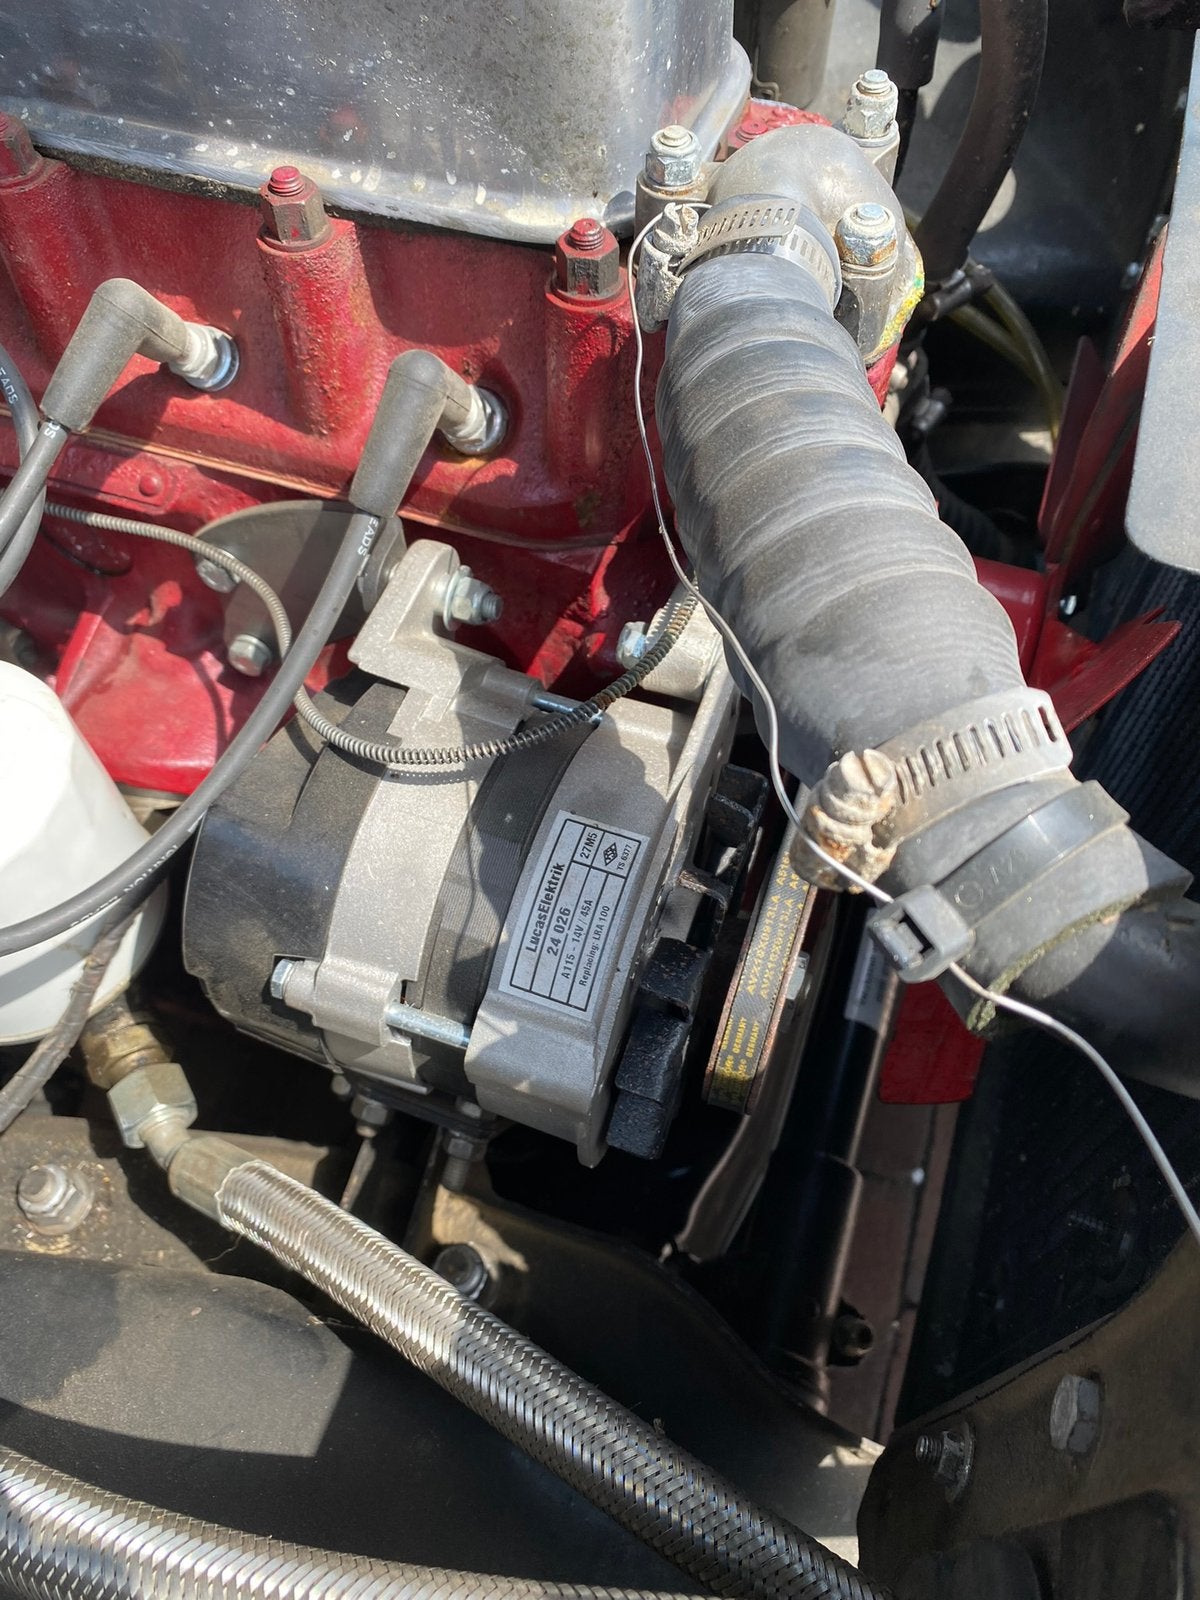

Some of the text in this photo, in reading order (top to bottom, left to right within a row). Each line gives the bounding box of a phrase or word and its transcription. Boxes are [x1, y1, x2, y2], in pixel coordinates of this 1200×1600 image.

[580, 832, 598, 859] 27M5
[616, 844, 632, 871] TS 6377
[525, 861, 566, 953] LucasElektrik
[546, 906, 571, 957] 24 026
[561, 953, 576, 979] A115
[572, 923, 585, 943] 14V
[582, 899, 594, 918] 45A
[578, 905, 610, 987] Replacing: LRA 100
